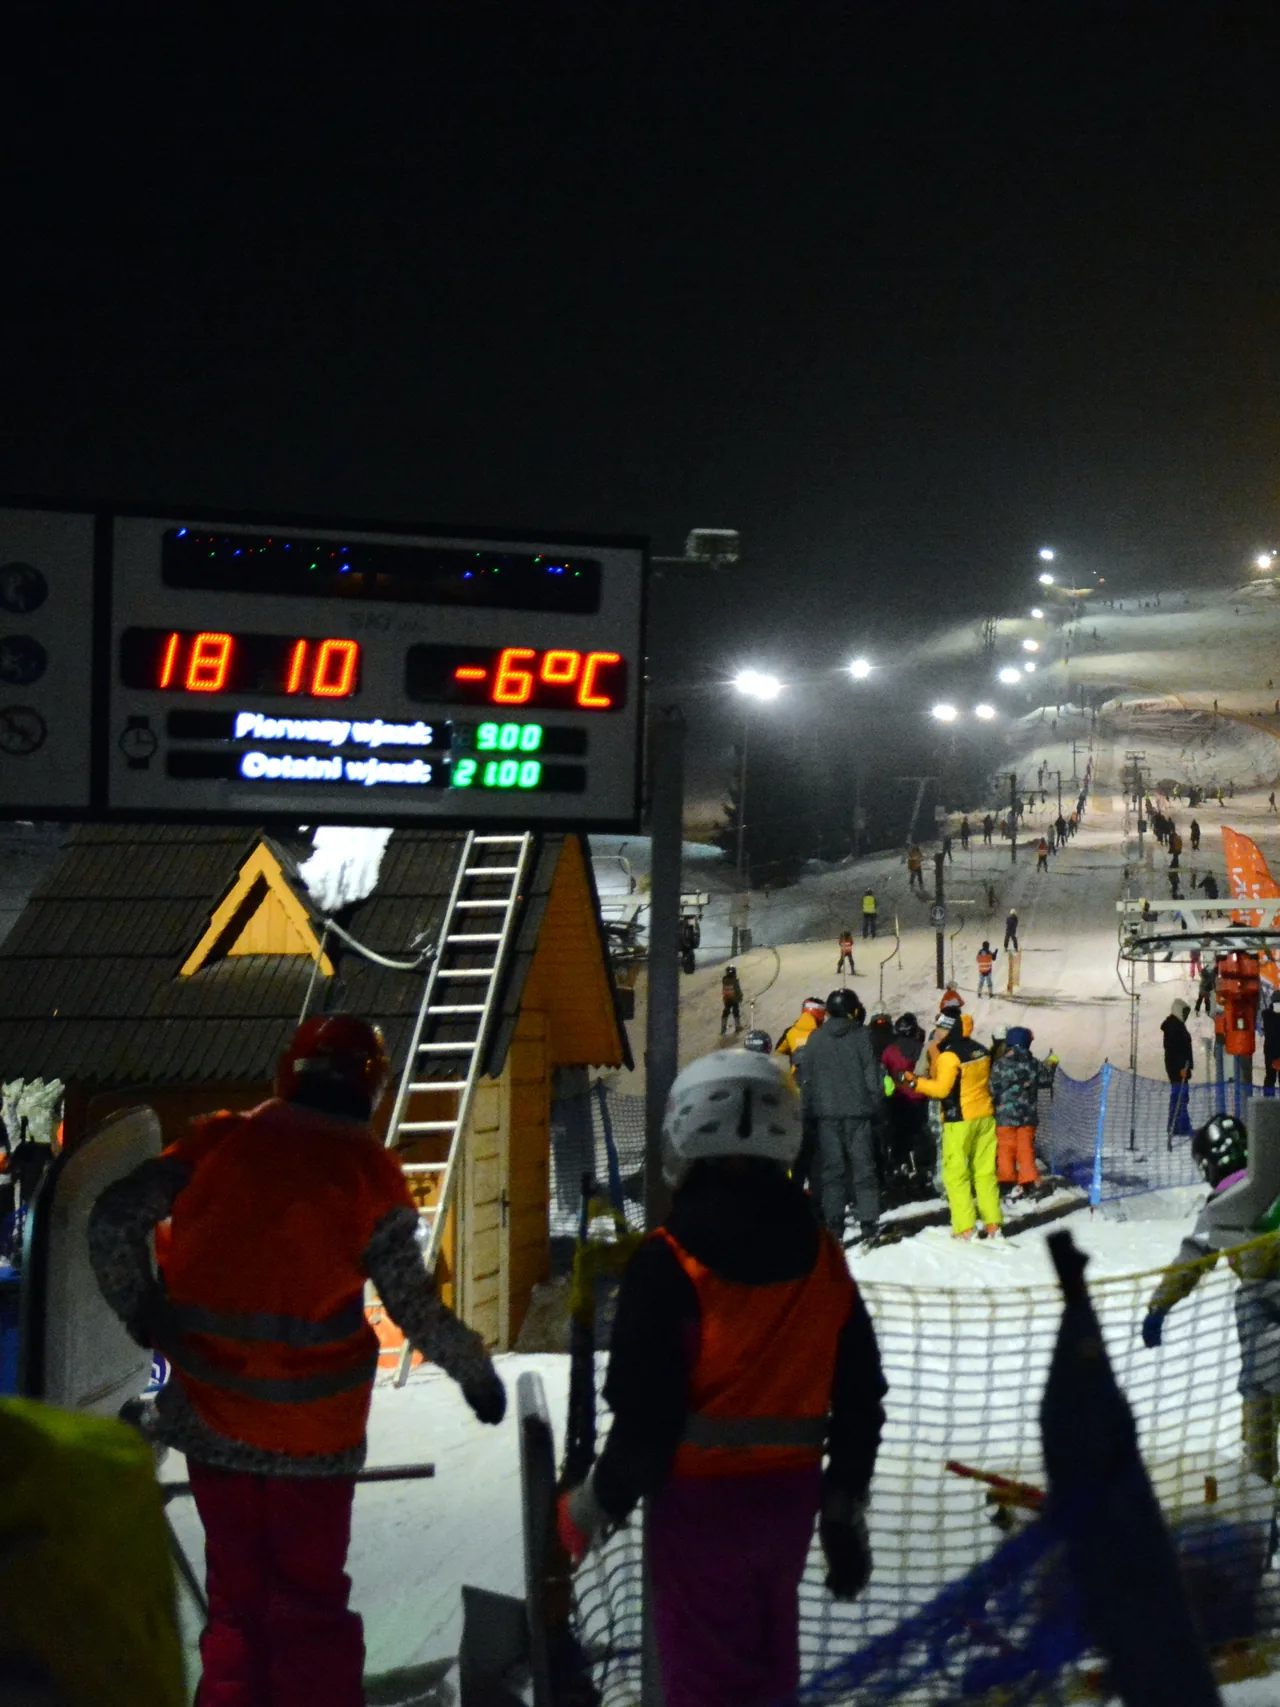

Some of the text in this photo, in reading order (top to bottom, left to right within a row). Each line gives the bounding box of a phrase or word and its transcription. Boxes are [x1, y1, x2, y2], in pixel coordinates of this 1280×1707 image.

[159, 632, 359, 697] 18 10
[241, 750, 343, 779] Ostatni
